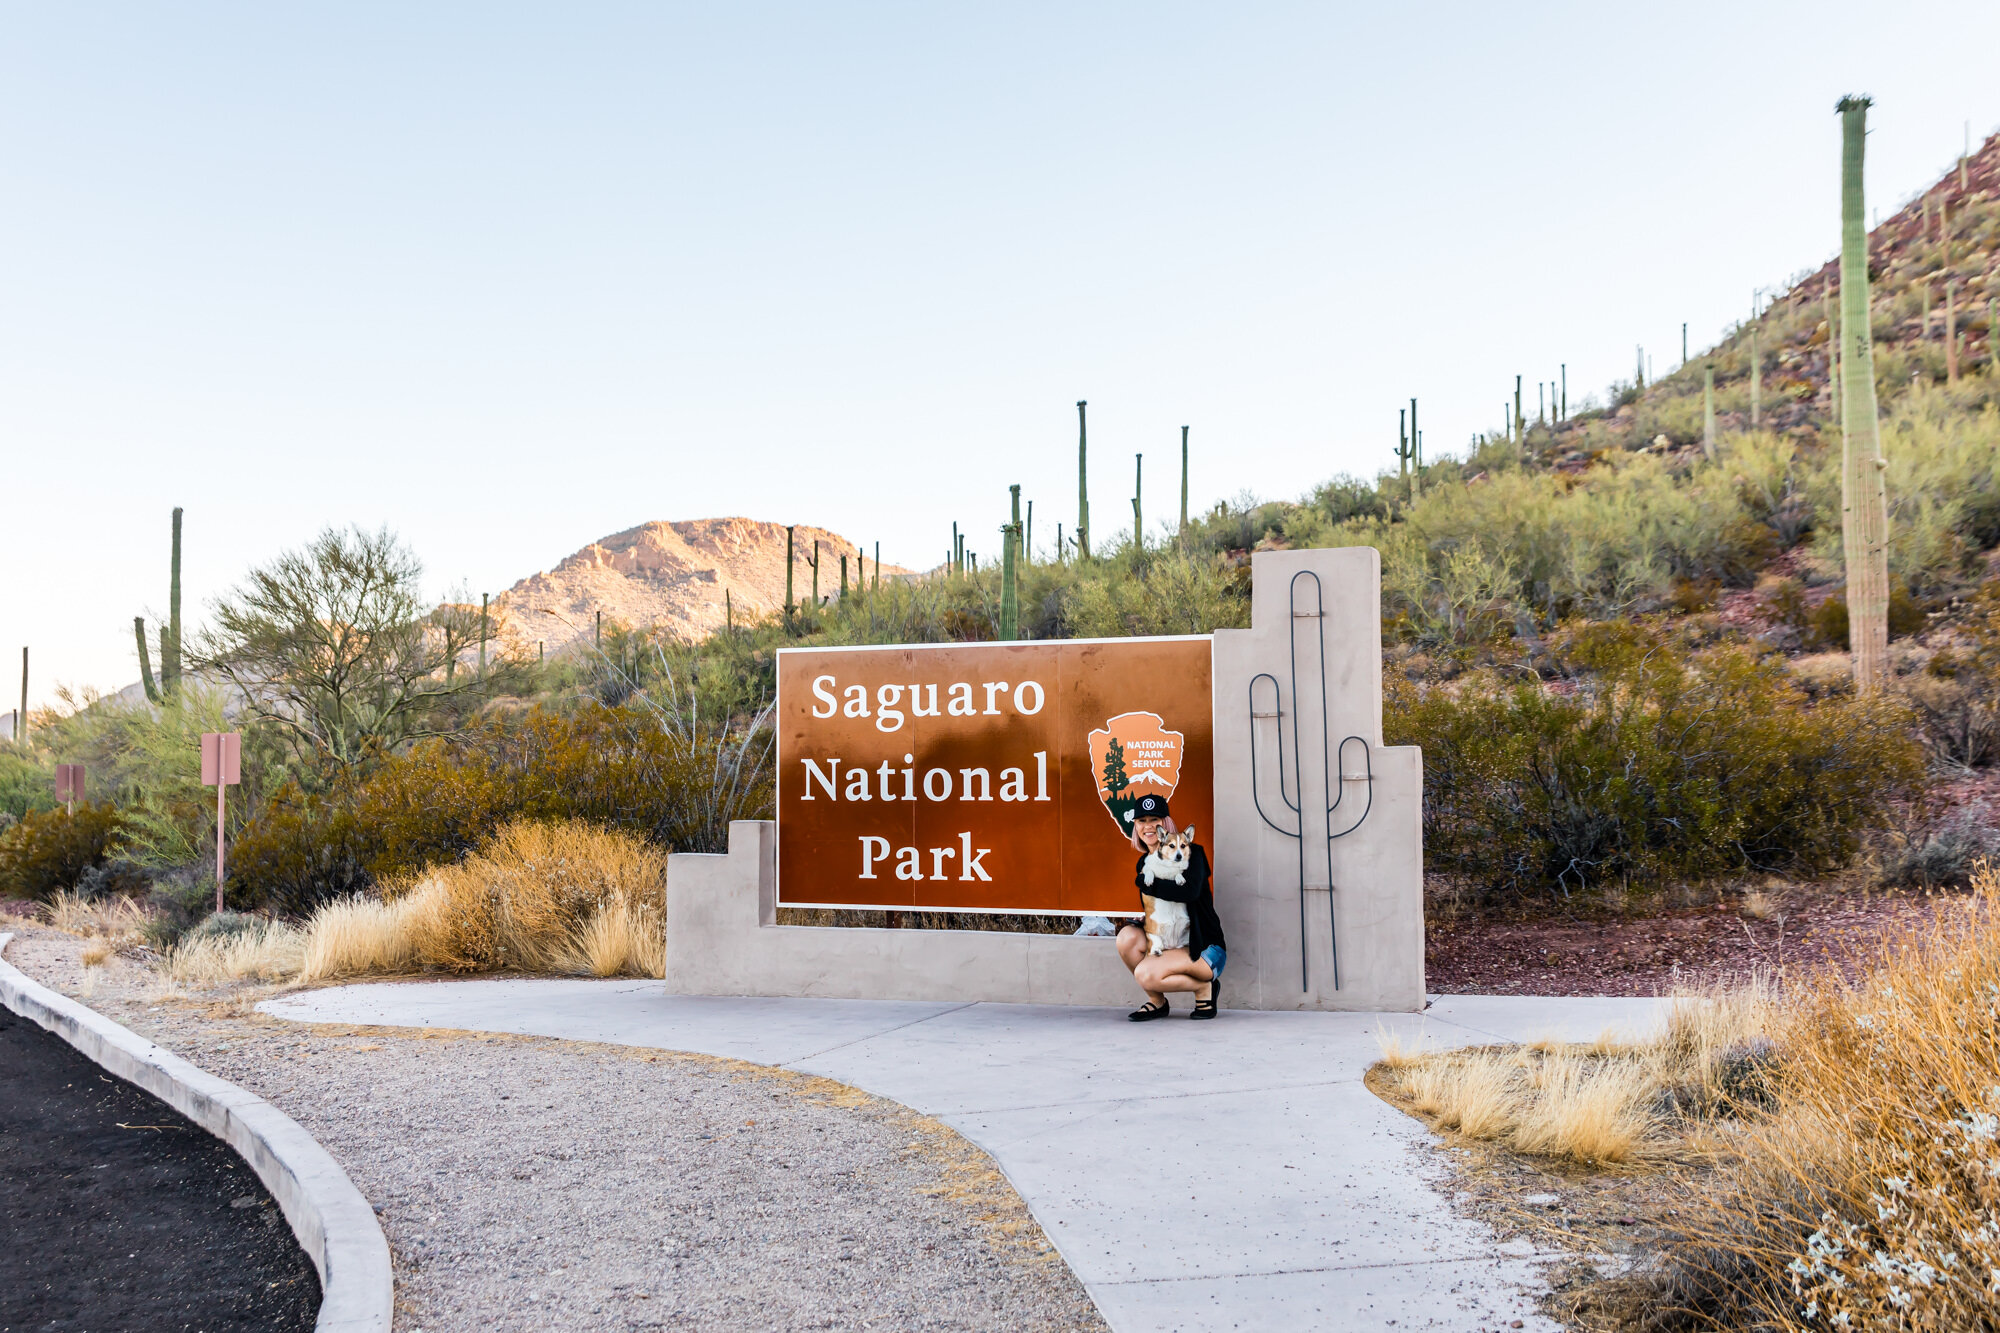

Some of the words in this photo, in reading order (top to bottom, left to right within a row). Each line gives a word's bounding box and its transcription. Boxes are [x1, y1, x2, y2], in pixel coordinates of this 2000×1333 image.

[812, 675, 1045, 733] Saguaro
[1127, 741, 1176, 749] NATIONAL
[1132, 760, 1171, 768] SERVICE
[801, 751, 1051, 801] National
[858, 832, 993, 882] Park
